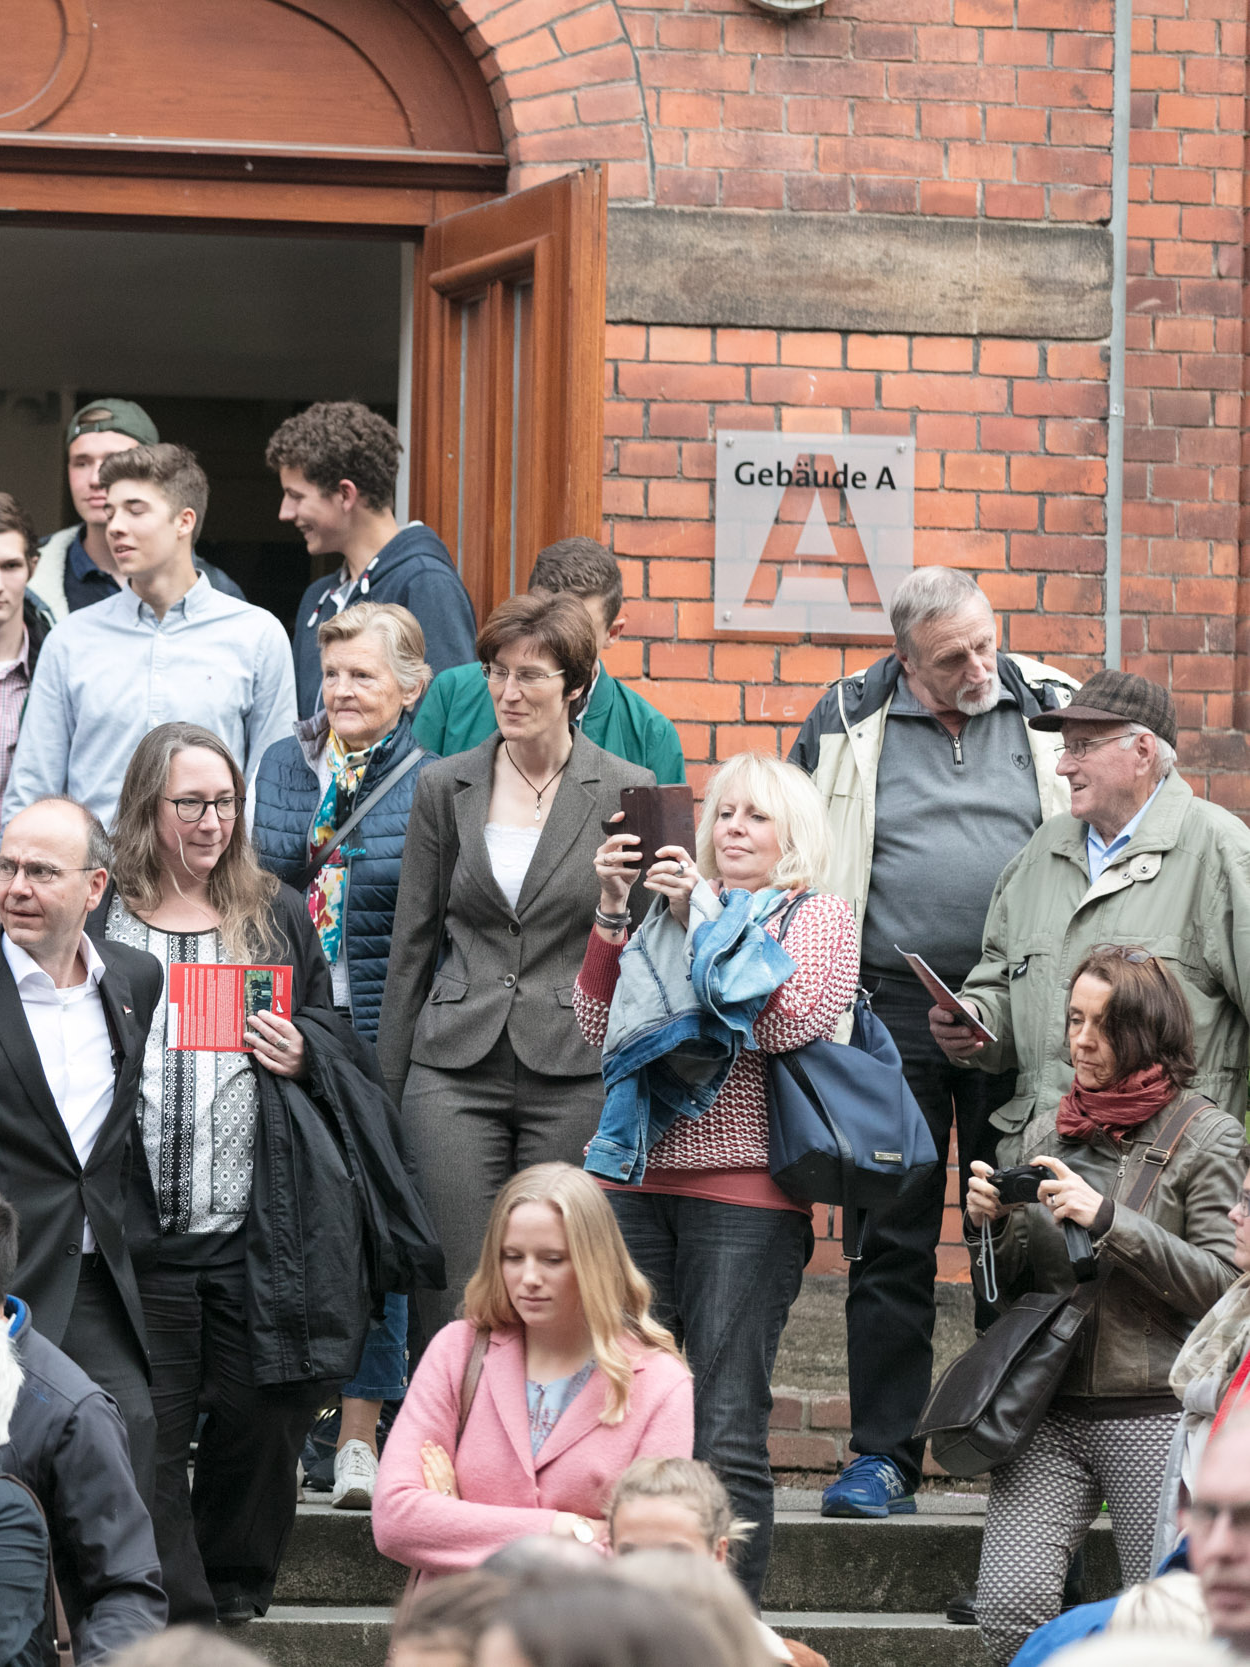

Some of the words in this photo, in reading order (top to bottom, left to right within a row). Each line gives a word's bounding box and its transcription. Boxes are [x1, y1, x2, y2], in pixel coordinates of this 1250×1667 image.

[734, 460, 867, 490] Gebäude
[875, 466, 897, 490] A
[742, 453, 885, 613] A
